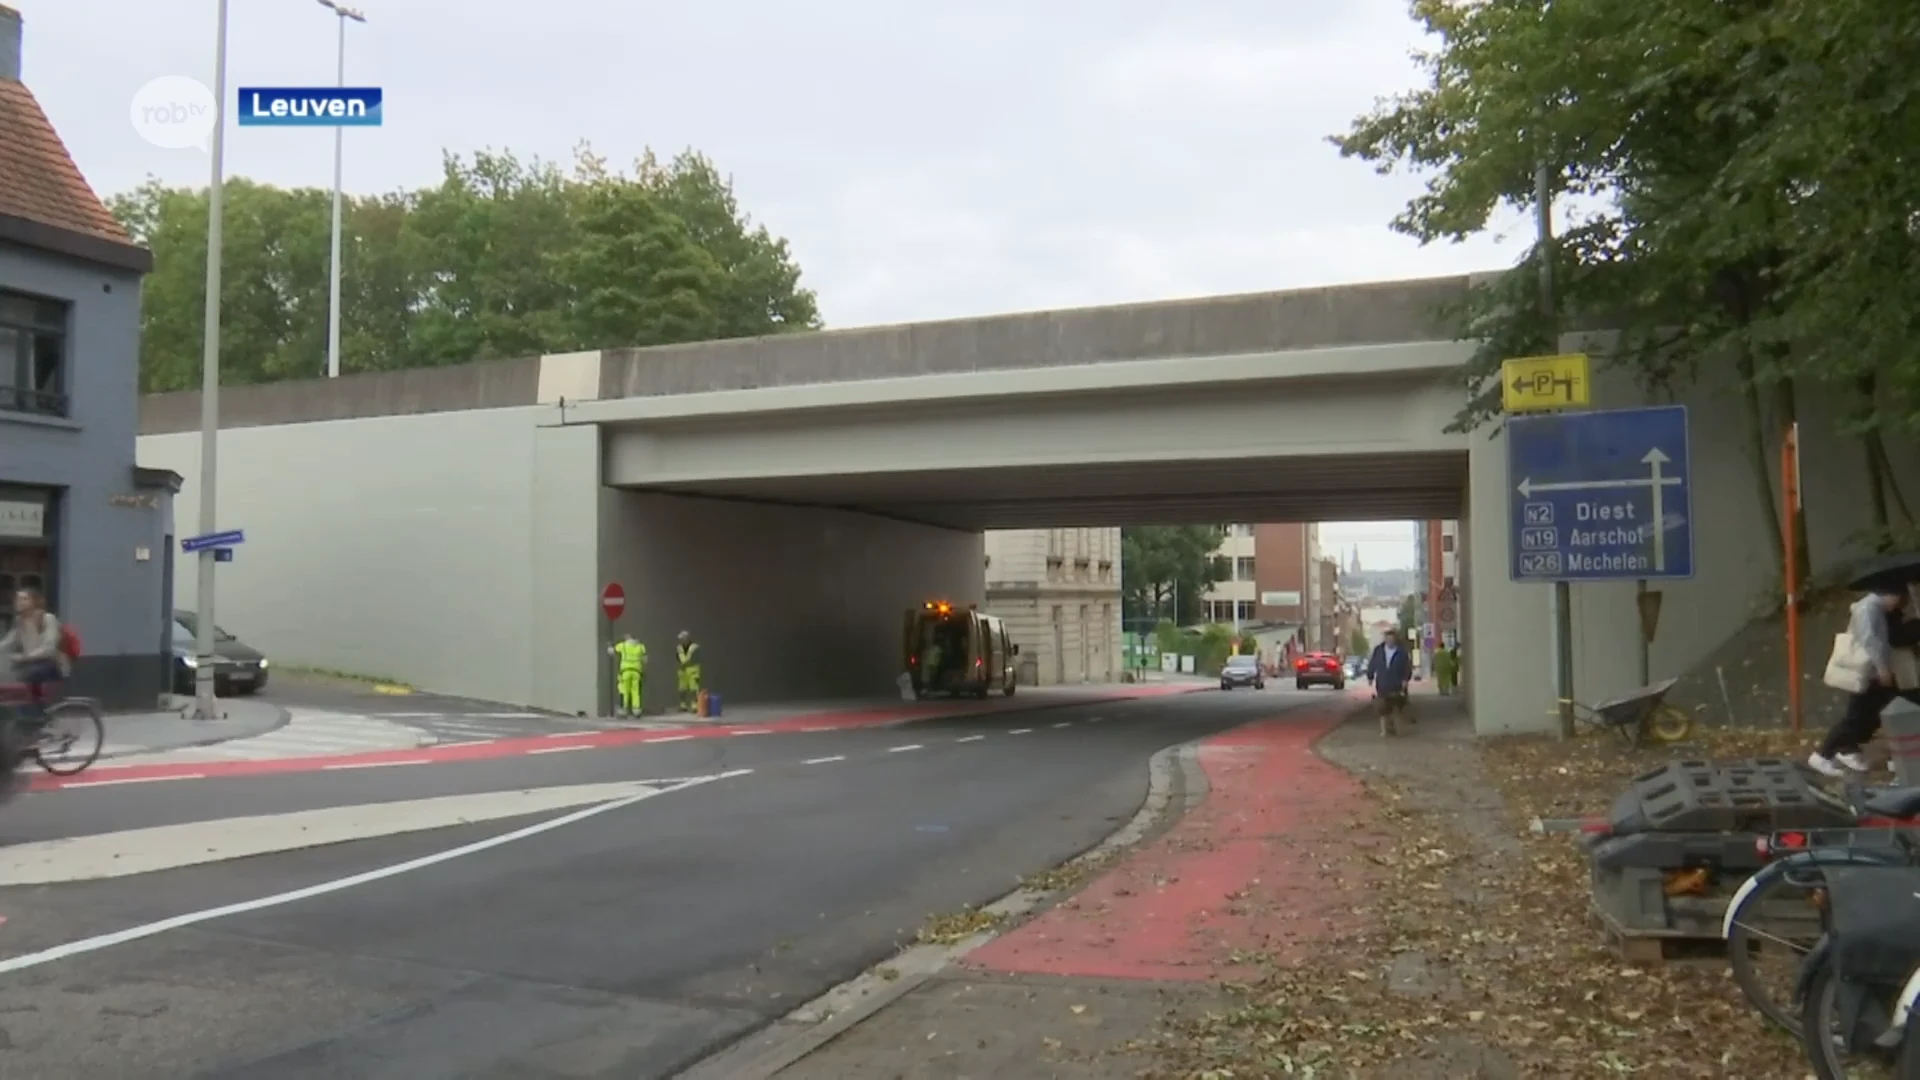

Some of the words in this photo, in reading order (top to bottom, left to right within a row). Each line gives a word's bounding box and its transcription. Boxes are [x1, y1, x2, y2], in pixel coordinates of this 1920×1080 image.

[1537, 375, 1550, 392] P
[1528, 506, 1549, 520] N2
[1576, 502, 1635, 521] Diest
[1525, 531, 1554, 546] N19
[1570, 526, 1645, 546] Aarschot
[1523, 555, 1558, 571] N26
[1568, 552, 1648, 572] Mechelen
